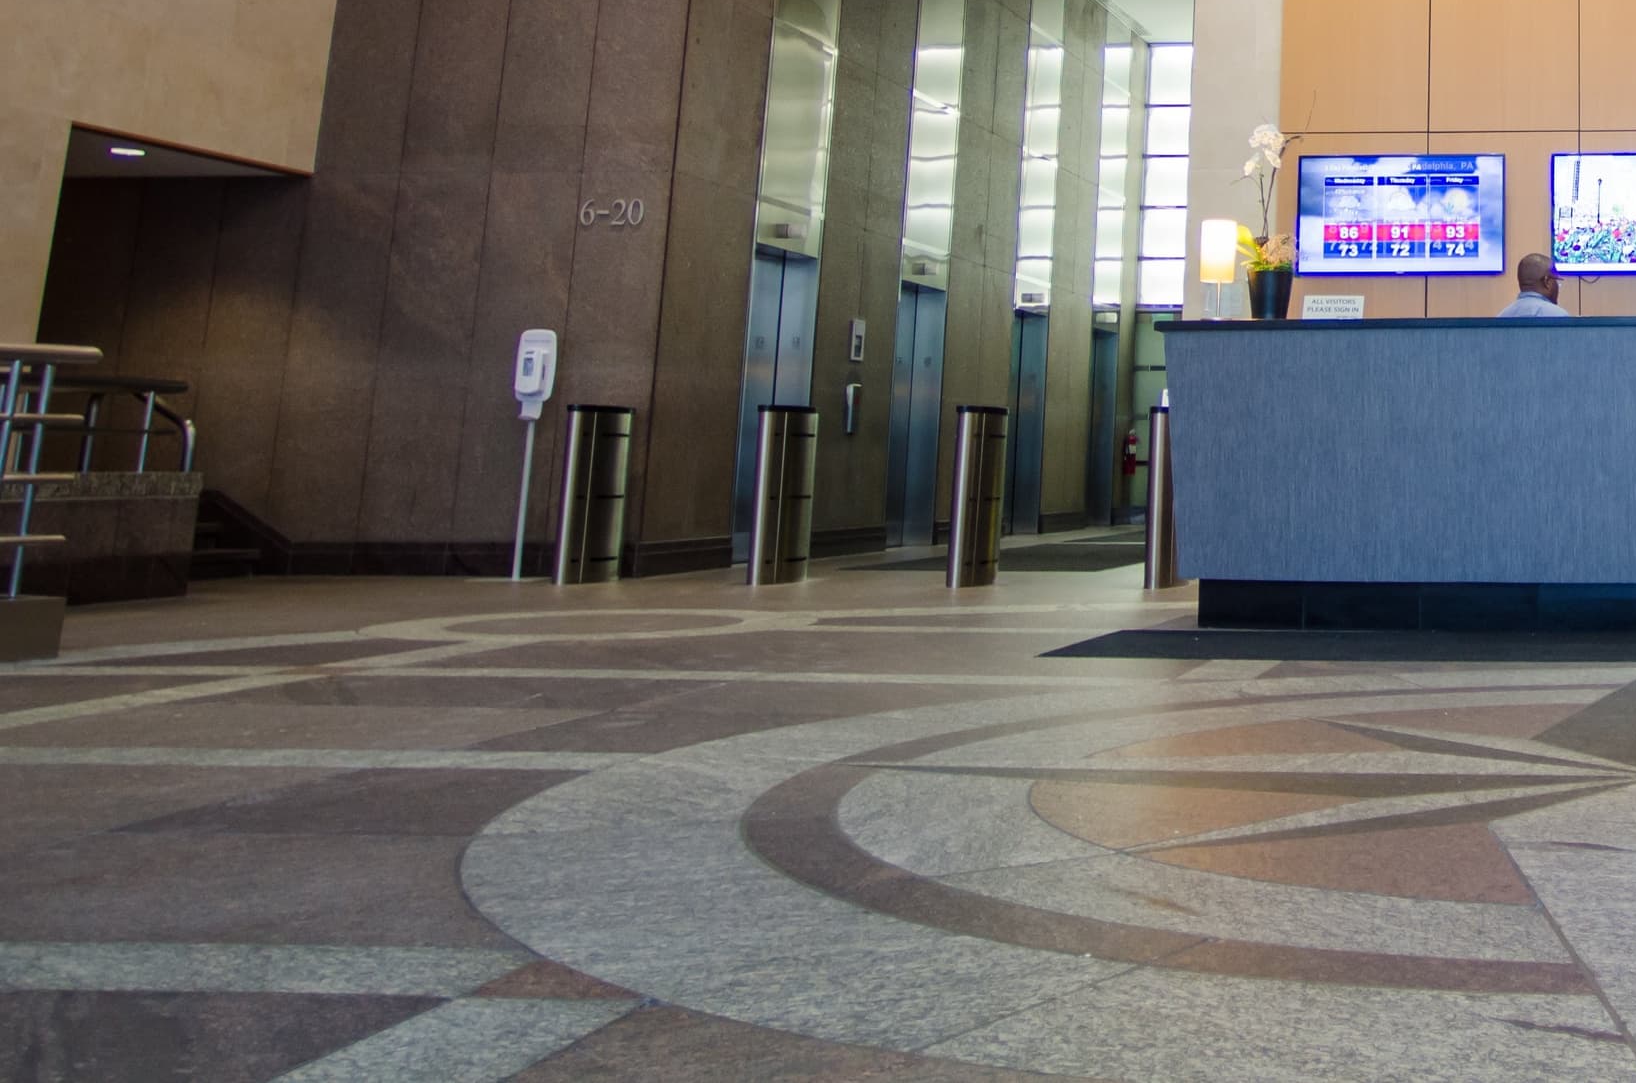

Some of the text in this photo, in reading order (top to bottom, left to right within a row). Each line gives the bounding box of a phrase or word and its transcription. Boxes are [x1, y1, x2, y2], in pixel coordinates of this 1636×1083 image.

[1460, 161, 1474, 170] PA
[580, 198, 644, 226] 6-20
[1339, 226, 1359, 239] 86
[1390, 226, 1409, 239] 91
[1445, 226, 1465, 238] 93
[1339, 243, 1359, 257] 73
[1390, 243, 1410, 257] 72
[1446, 243, 1466, 257] 74
